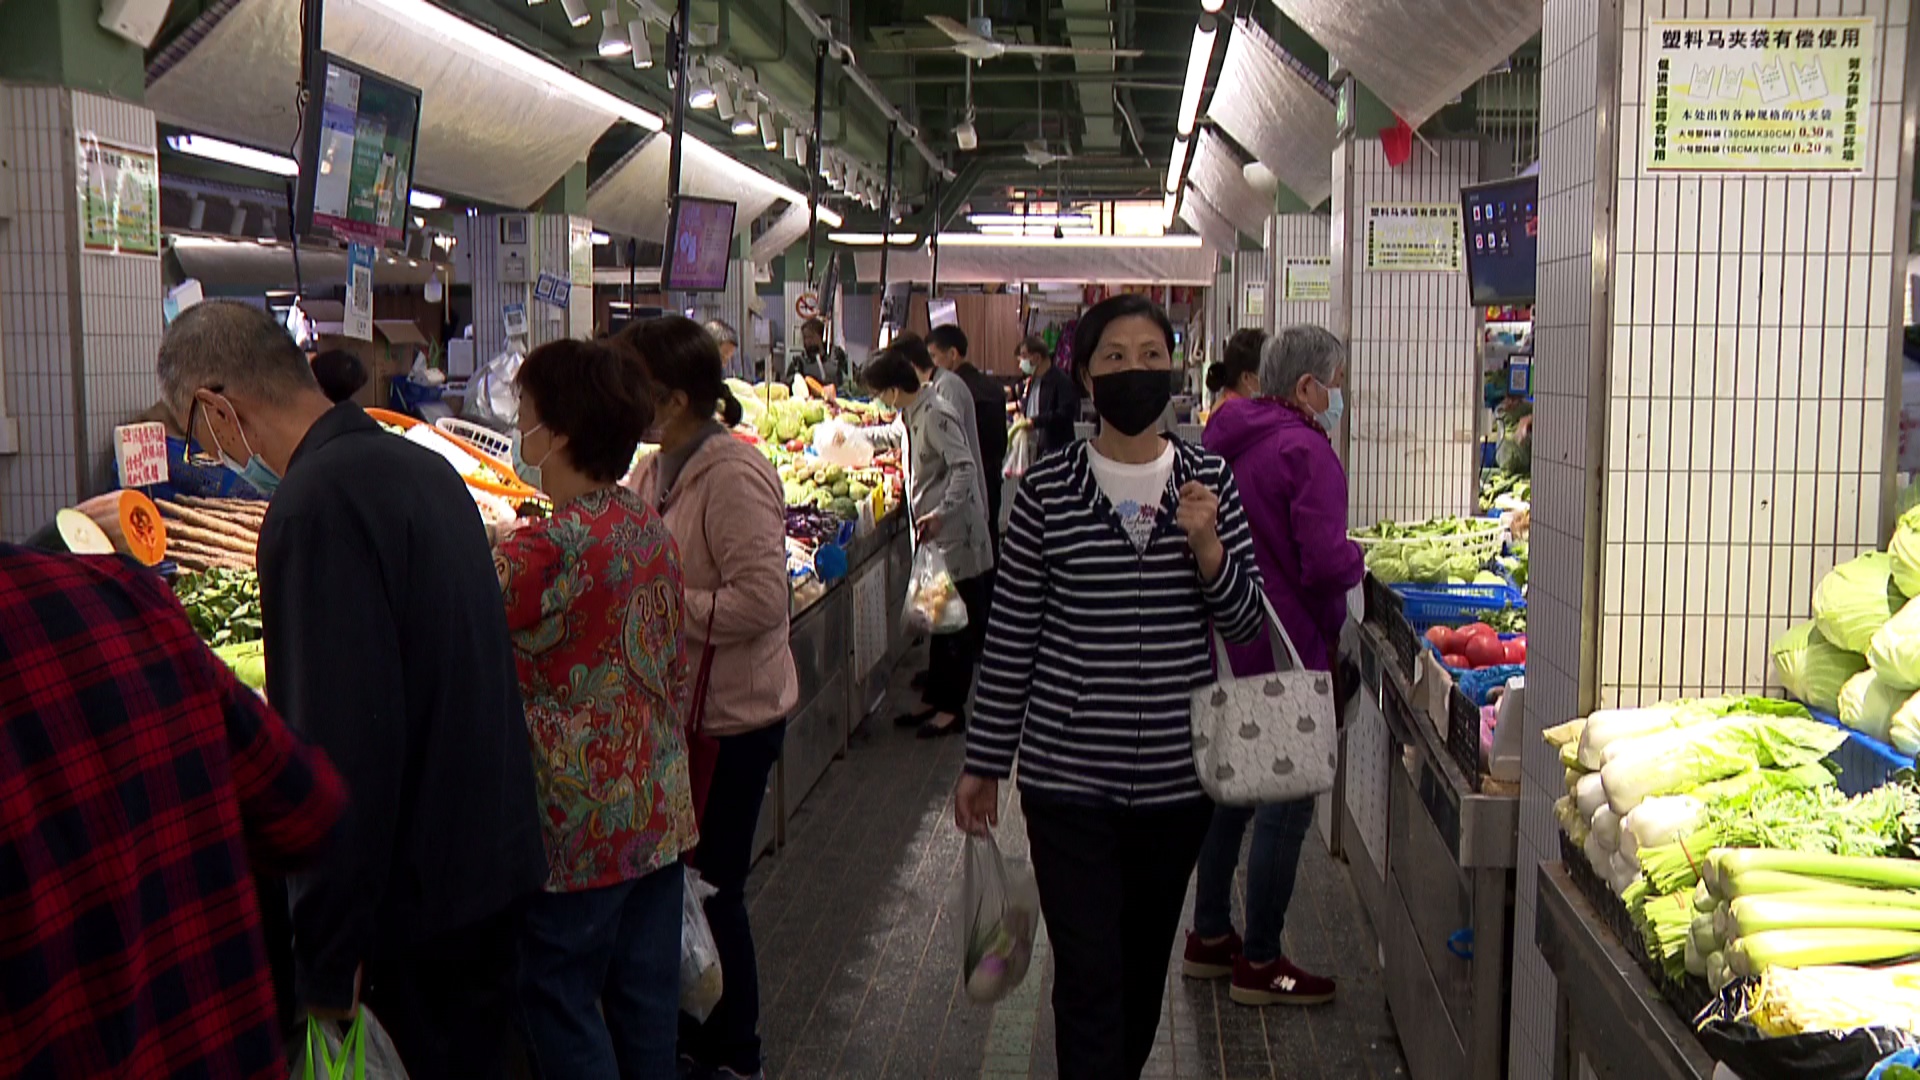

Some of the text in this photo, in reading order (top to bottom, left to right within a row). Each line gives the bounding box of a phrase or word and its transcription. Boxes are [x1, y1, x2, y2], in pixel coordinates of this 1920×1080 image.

[1662, 28, 1860, 49] 塑料马夹袋有偿使用
[1682, 109, 1832, 121] 本处出售各种规格的马夹袋
[1842, 57, 1861, 161] 努力保护生态环境
